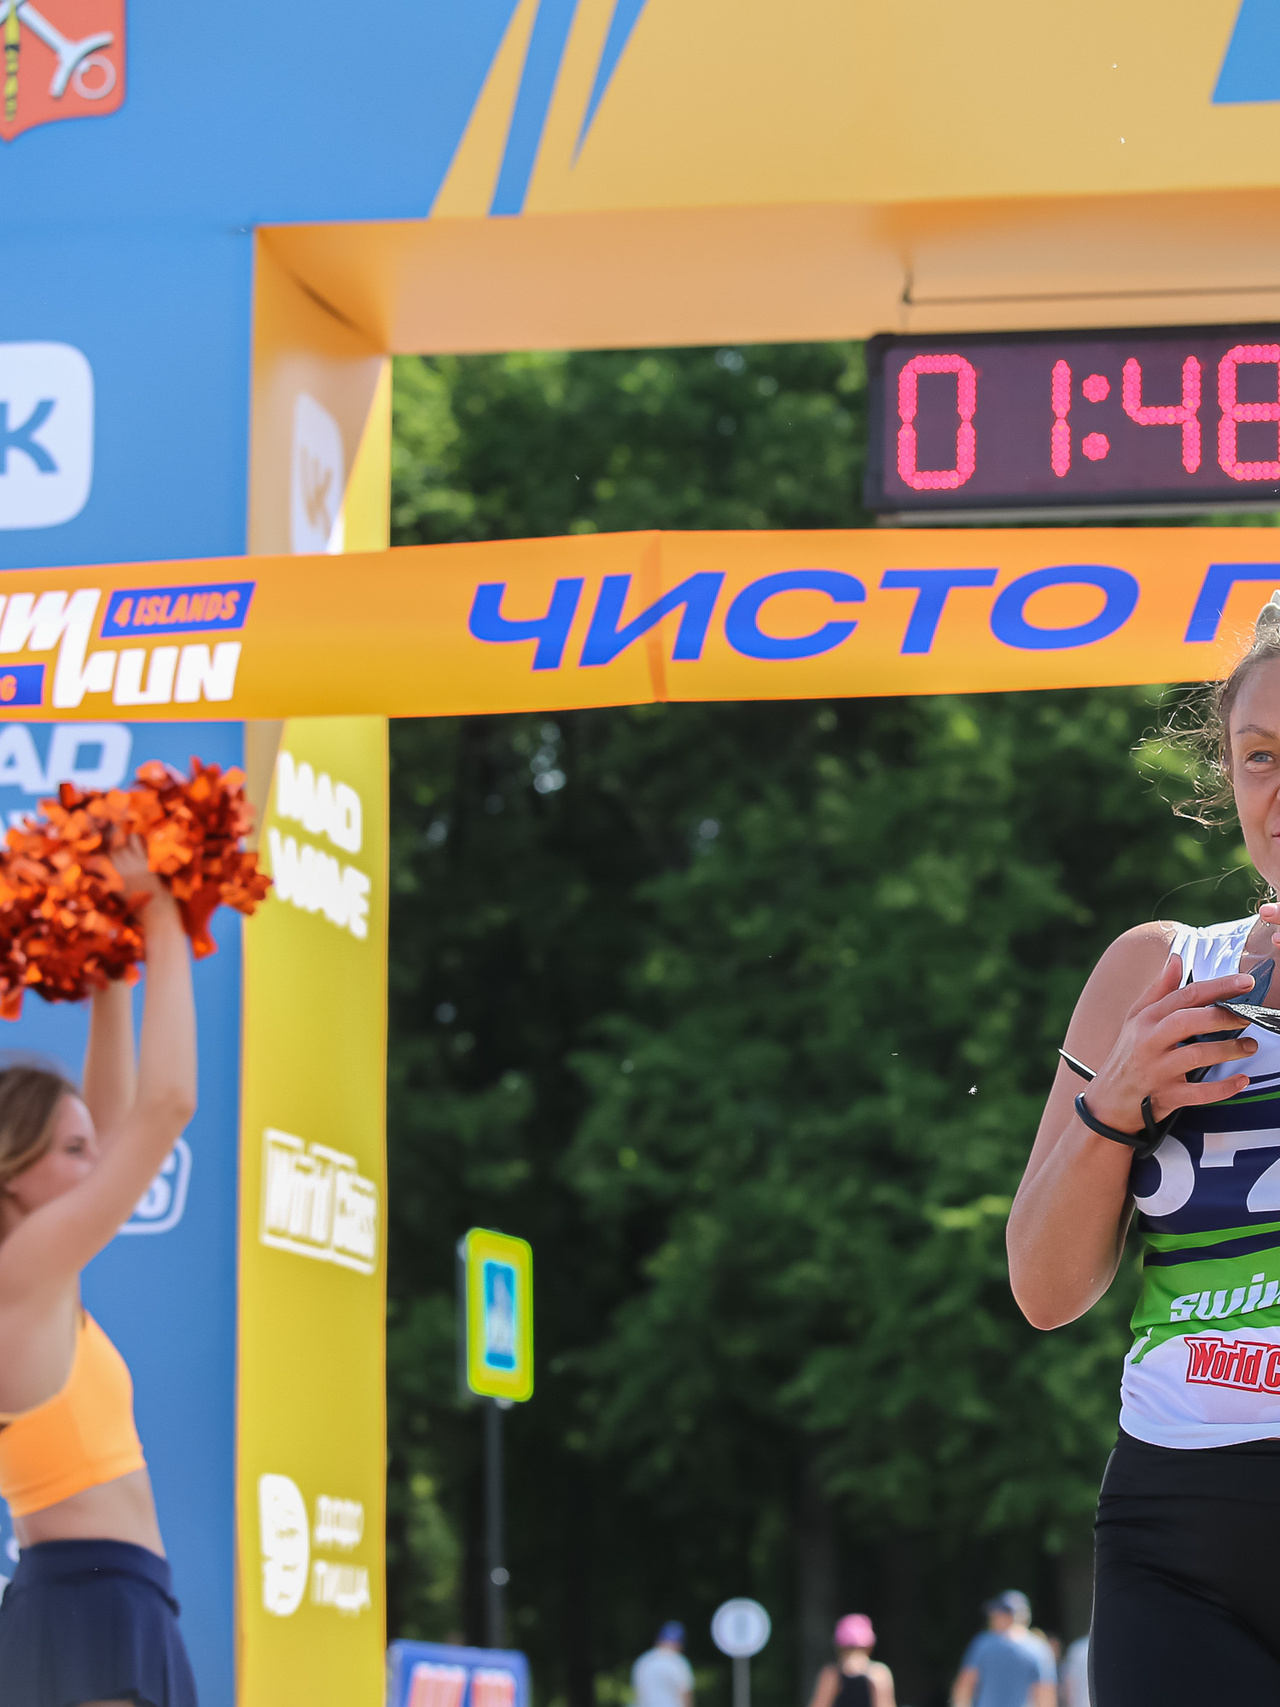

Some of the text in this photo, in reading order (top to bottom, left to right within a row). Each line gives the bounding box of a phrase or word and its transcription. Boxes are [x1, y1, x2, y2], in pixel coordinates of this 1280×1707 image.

[113, 590, 241, 627] 4 ISLANDS
[468, 564, 1141, 672] ЧИСТО
[1191, 1341, 1263, 1385] World
